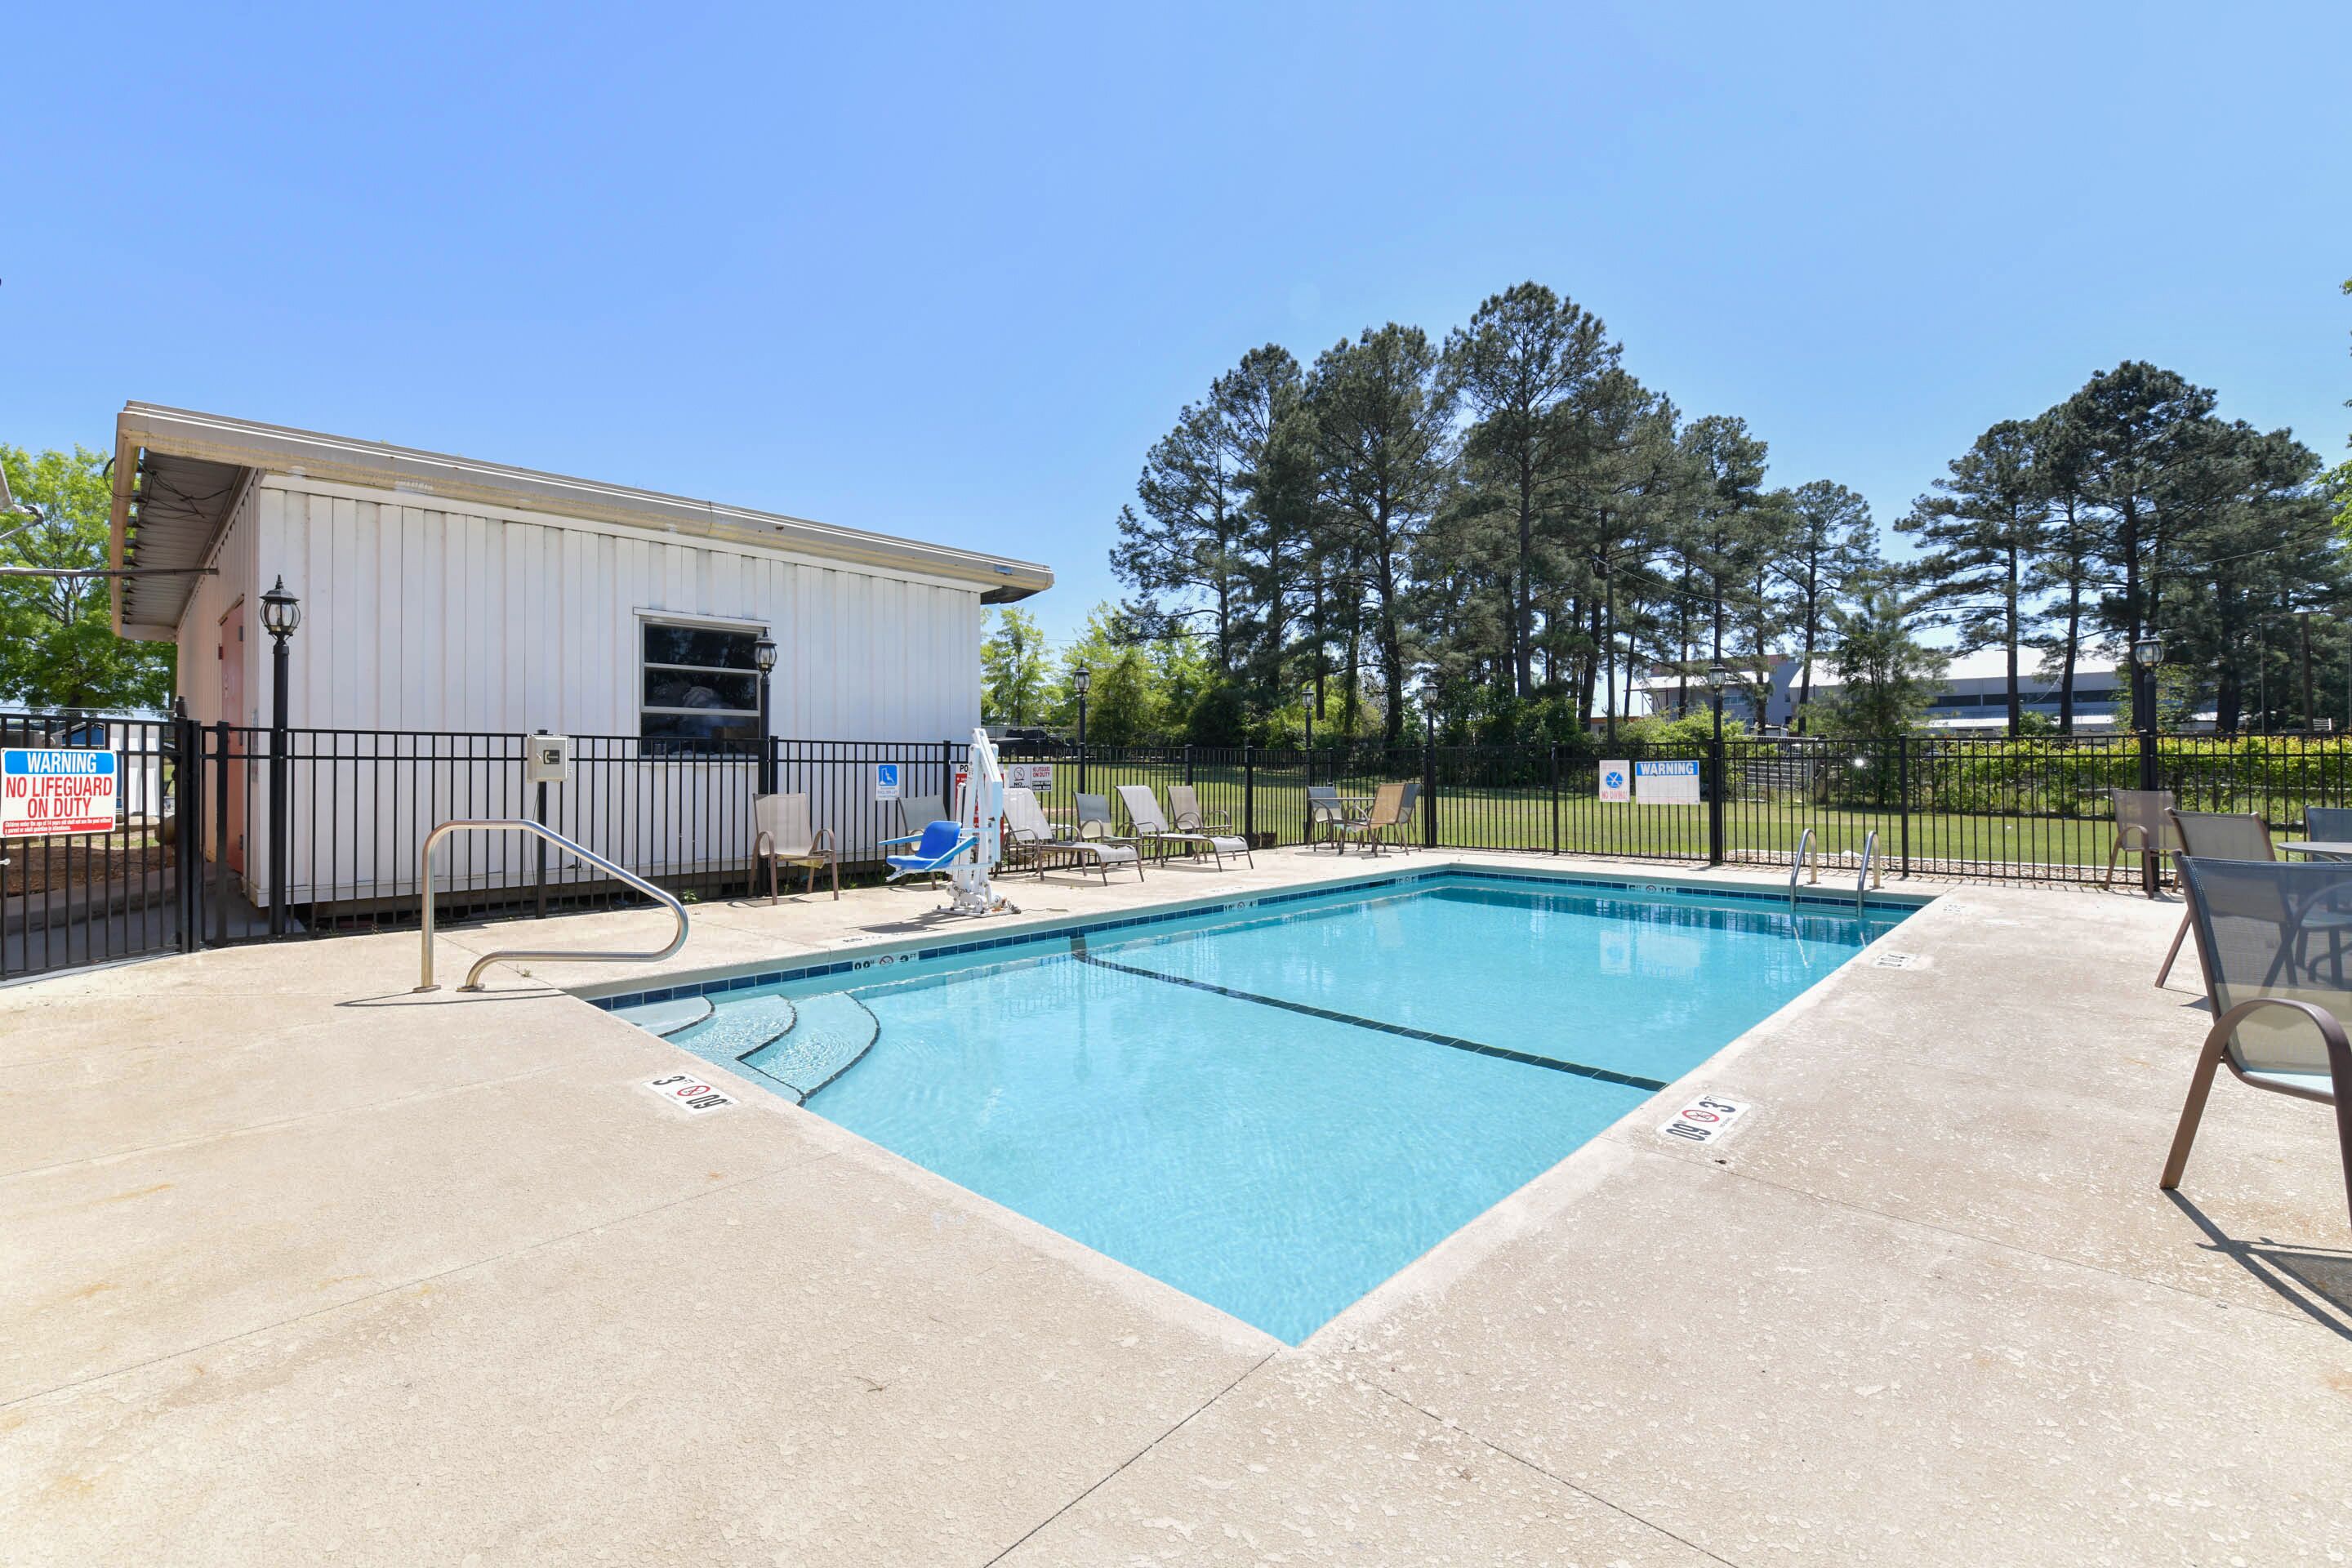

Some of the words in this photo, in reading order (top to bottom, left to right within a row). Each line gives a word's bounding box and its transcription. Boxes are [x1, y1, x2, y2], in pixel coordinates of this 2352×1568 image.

[27, 752, 96, 773] WARNING
[1640, 763, 1694, 775] WARNING
[6, 777, 27, 798] NO
[32, 777, 113, 797] LIFEGUARD
[1601, 791, 1608, 800] NO
[28, 798, 48, 818] ON
[53, 797, 91, 817] DUTY
[653, 1076, 686, 1085] 3
[1699, 1101, 1736, 1113] 3
